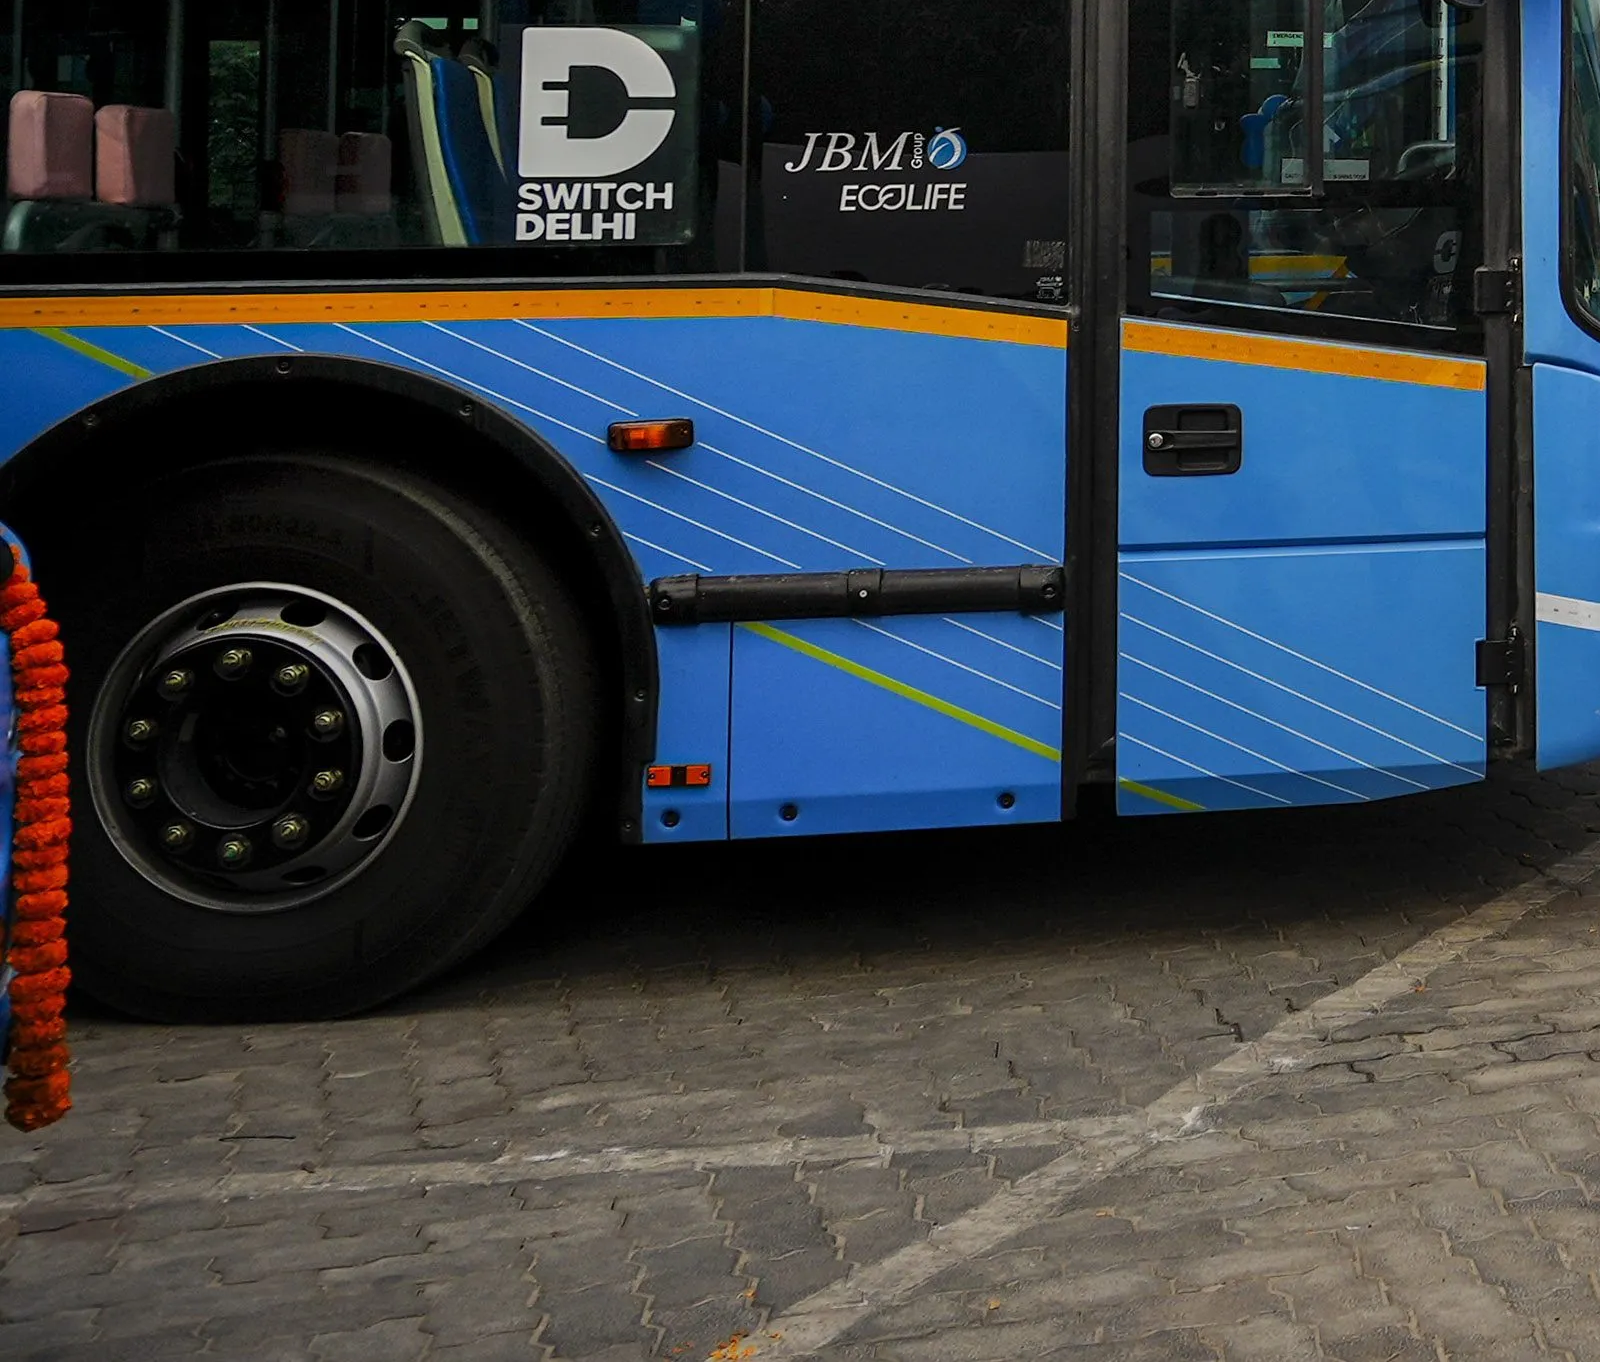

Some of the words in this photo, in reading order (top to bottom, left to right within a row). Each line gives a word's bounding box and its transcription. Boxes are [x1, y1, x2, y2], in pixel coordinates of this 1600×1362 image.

[784, 132, 914, 172] JBM
[911, 133, 925, 169] Group
[517, 182, 674, 211] SWITCH
[839, 183, 967, 211] ECOLIFE
[515, 212, 636, 241] DELHI
